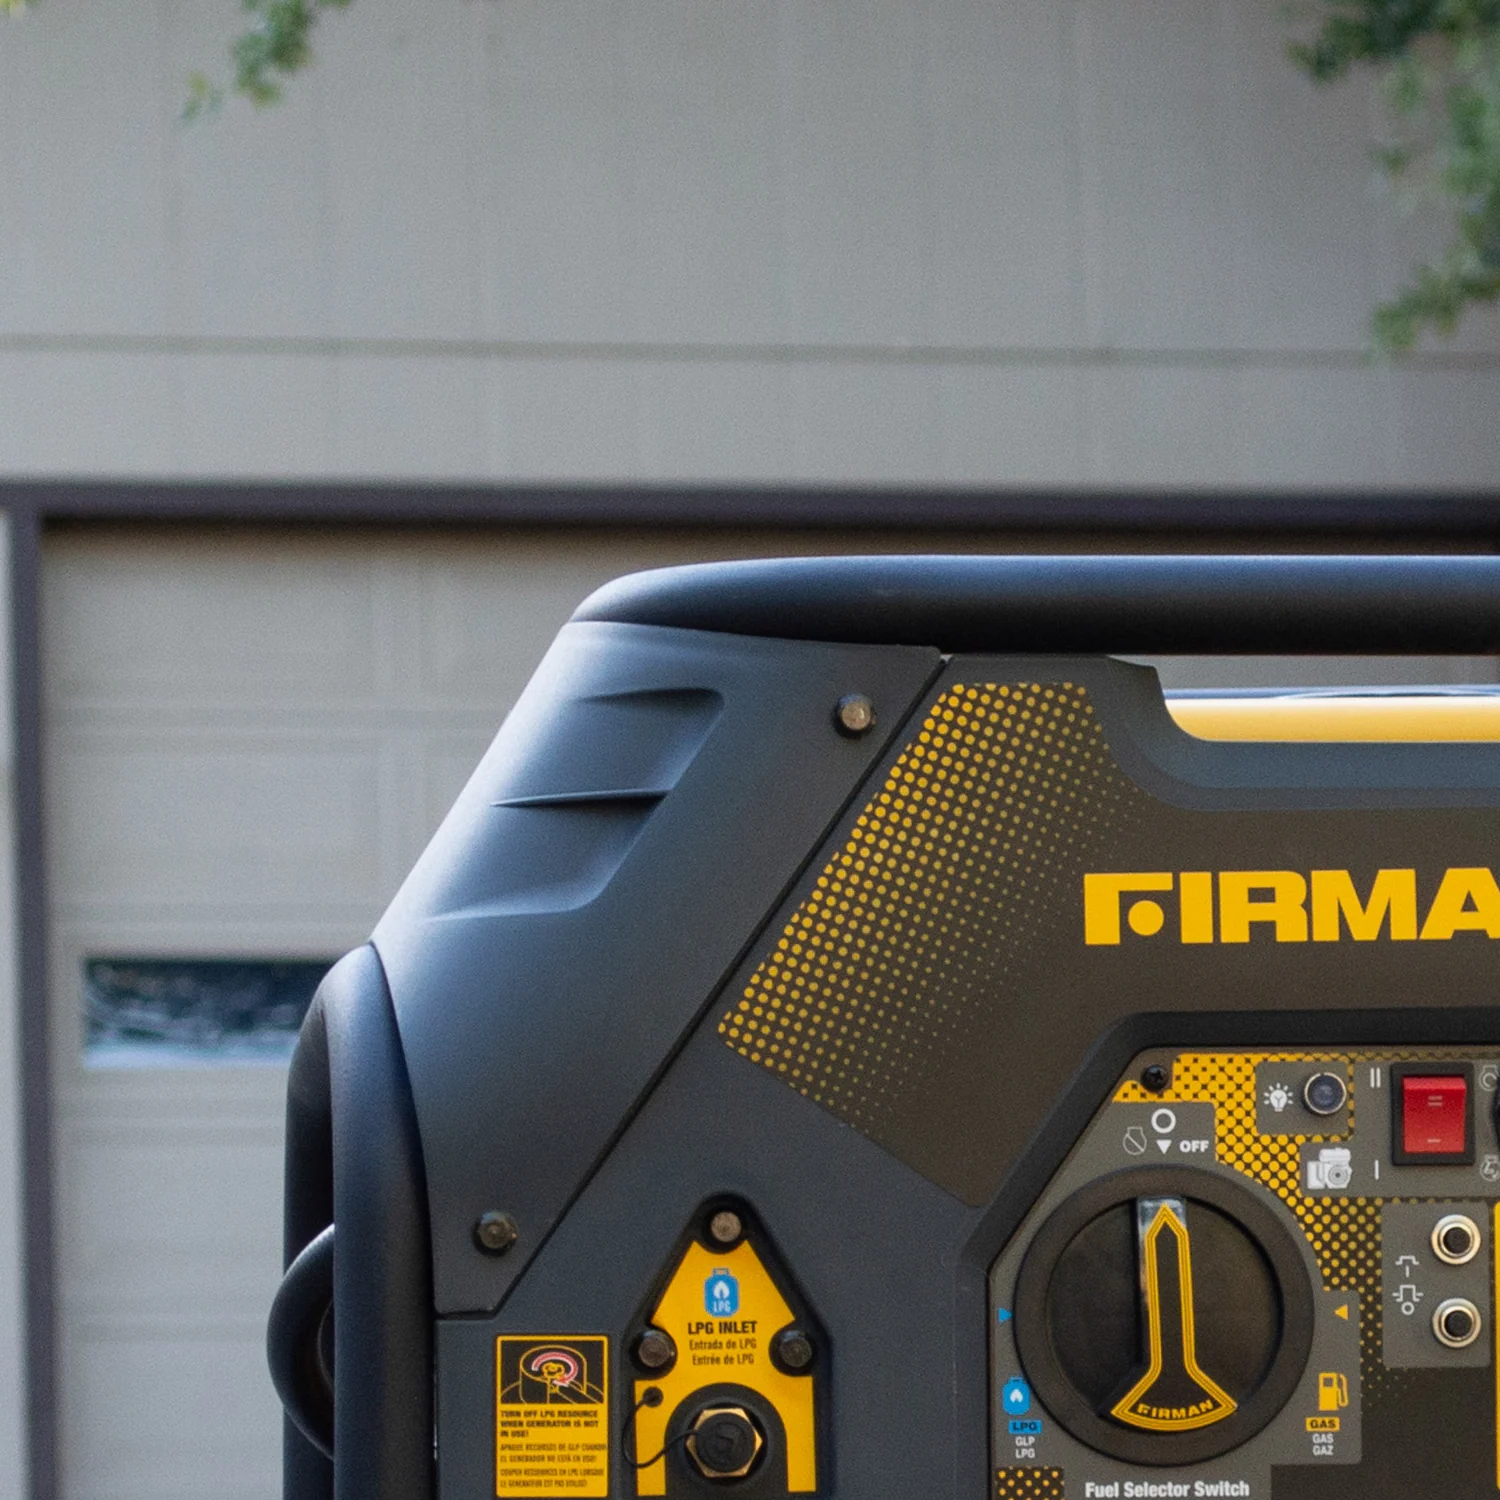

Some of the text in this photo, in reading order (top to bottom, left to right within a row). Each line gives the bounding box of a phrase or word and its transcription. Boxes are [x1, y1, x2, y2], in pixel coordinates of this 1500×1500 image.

[1179, 1140, 1209, 1153] OFF
[713, 1300, 731, 1313] LPG
[688, 1321, 757, 1335] LPG INLET
[689, 1338, 757, 1351] Entrada de LPG
[723, 1354, 734, 1365] de
[737, 1353, 754, 1365] LPG
[1137, 1399, 1213, 1420] FIRMAN
[1012, 1421, 1038, 1431] LPG
[1310, 1419, 1336, 1429] GAS
[1015, 1436, 1036, 1447] GLP
[1312, 1433, 1334, 1444] GAS
[1015, 1448, 1036, 1459] LPG
[1312, 1445, 1334, 1456] GAZ
[1085, 1481, 1250, 1498] Fuel Selector Switch
